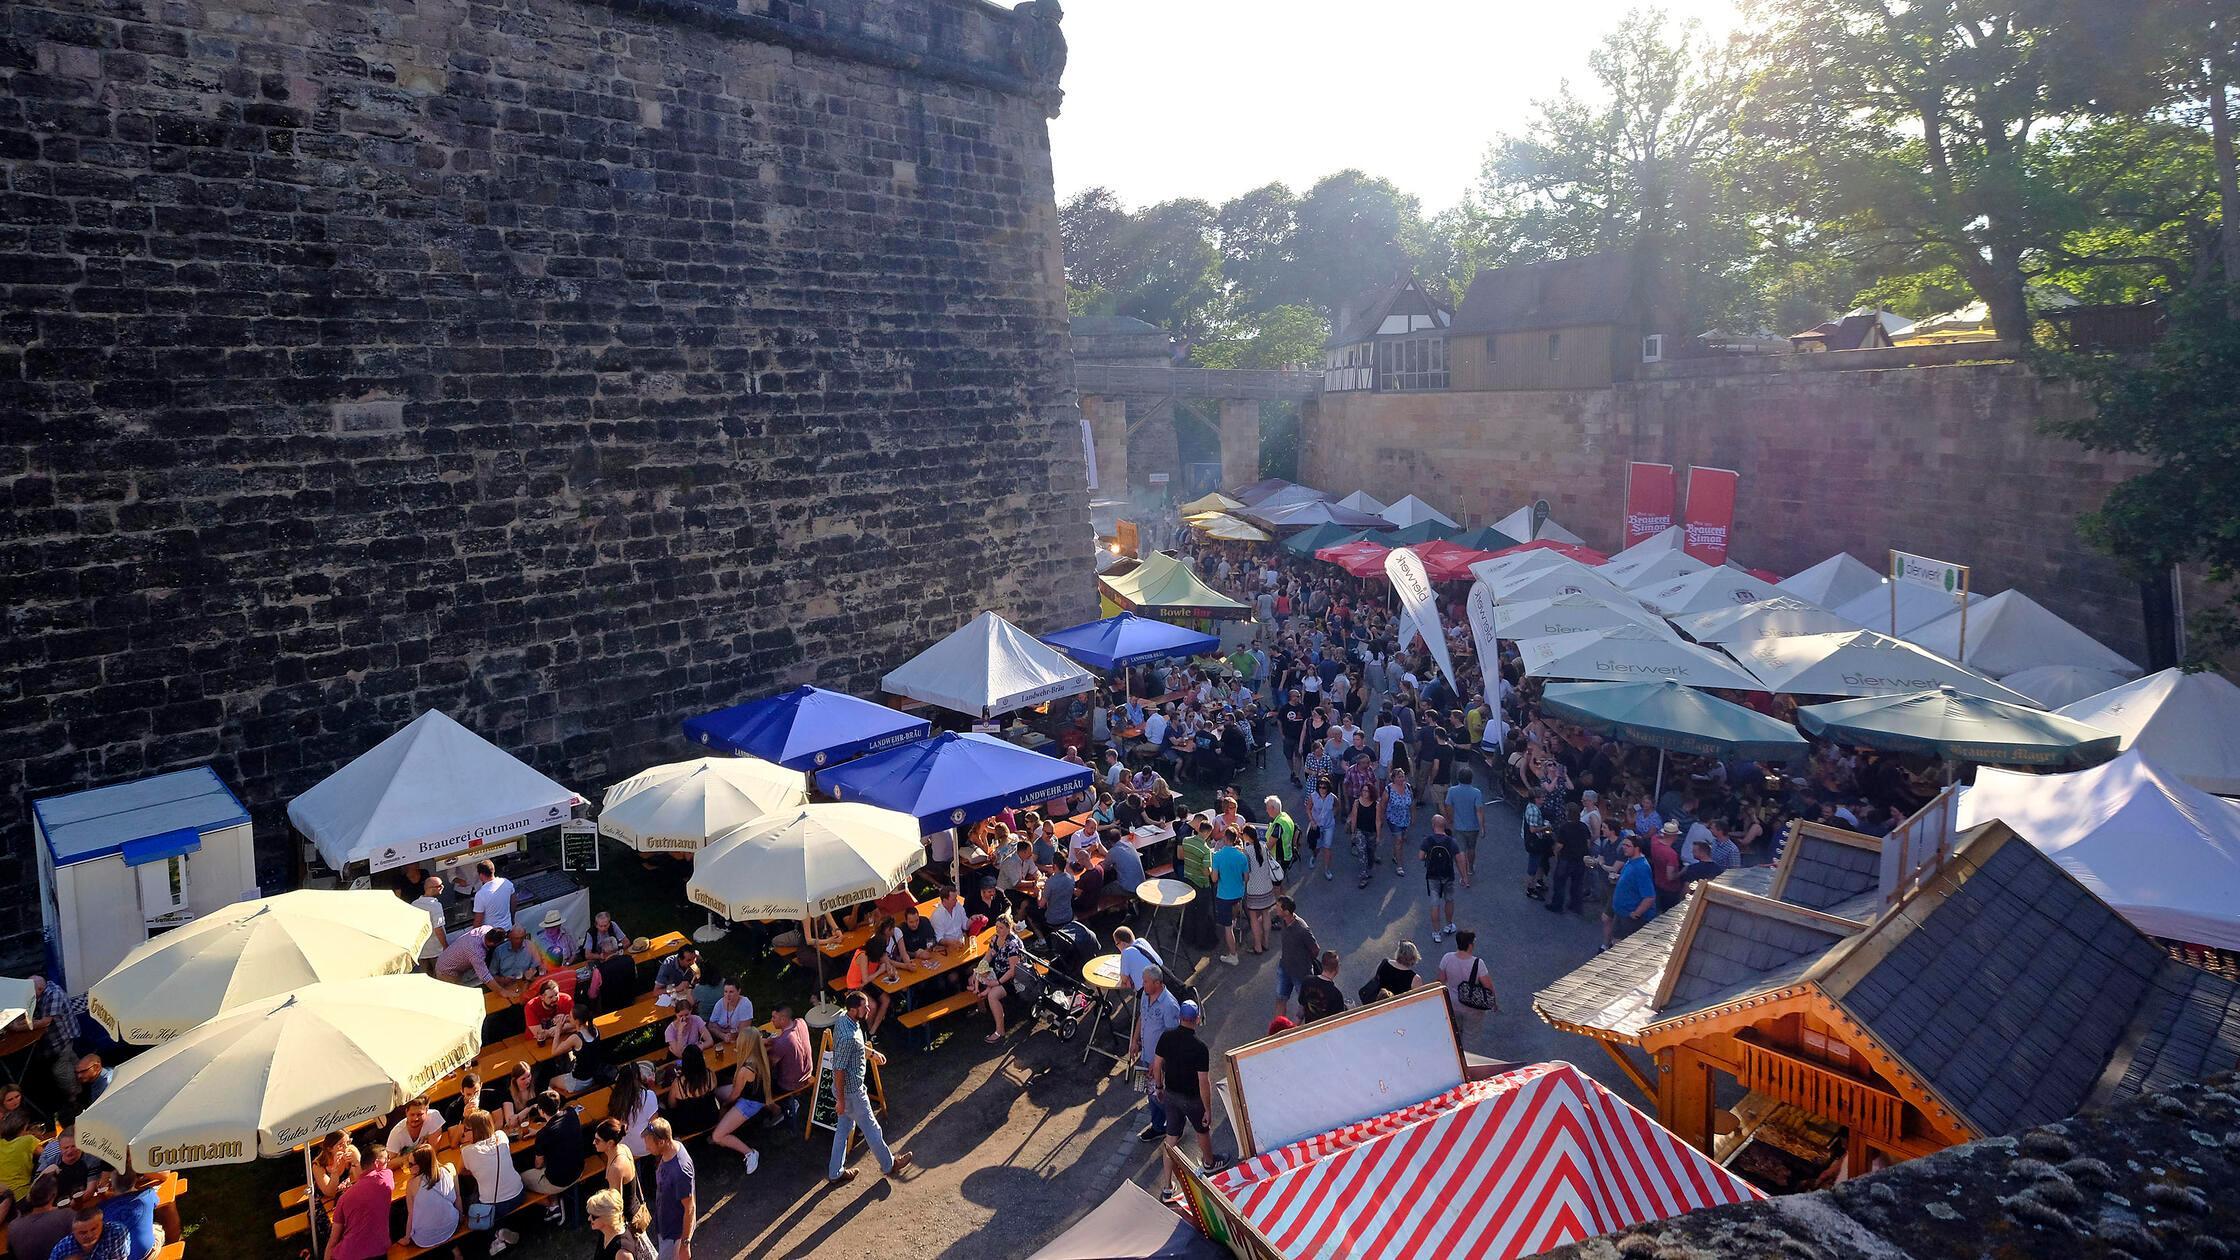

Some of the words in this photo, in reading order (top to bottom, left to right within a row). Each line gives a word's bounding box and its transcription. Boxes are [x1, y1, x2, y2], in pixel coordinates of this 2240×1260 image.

[1628, 514, 1670, 524] Brauerei
[1632, 523, 1666, 533] Simon
[1685, 523, 1726, 535] Brauerei
[1688, 533, 1722, 543] Simon
[1906, 560, 1941, 581] bierwerk
[1160, 608, 1191, 617] Bowle
[1193, 609, 1212, 617] Bar
[1595, 660, 1690, 676] bierwerk
[1841, 672, 1946, 688] bierwerk
[1021, 686, 1065, 702] Landwehr-Bräu
[869, 729, 922, 749] LANDWEHR-BRÄU
[1019, 779, 1084, 804] LANDWEHR-BRÄU
[418, 831, 471, 853] Brauerei
[474, 818, 531, 839] Gutmann
[647, 837, 698, 850] Gutmann
[694, 888, 726, 914] Gutmann
[819, 885, 877, 912] Gutmann
[741, 905, 760, 915] Gutes
[761, 904, 799, 915] Hefeweizen
[128, 1027, 154, 1041] Gutes
[407, 1042, 470, 1093] Gutmann
[276, 1125, 308, 1145] Gutes
[312, 1102, 378, 1133] Hefeweizen
[147, 1140, 243, 1167] Gutmann
